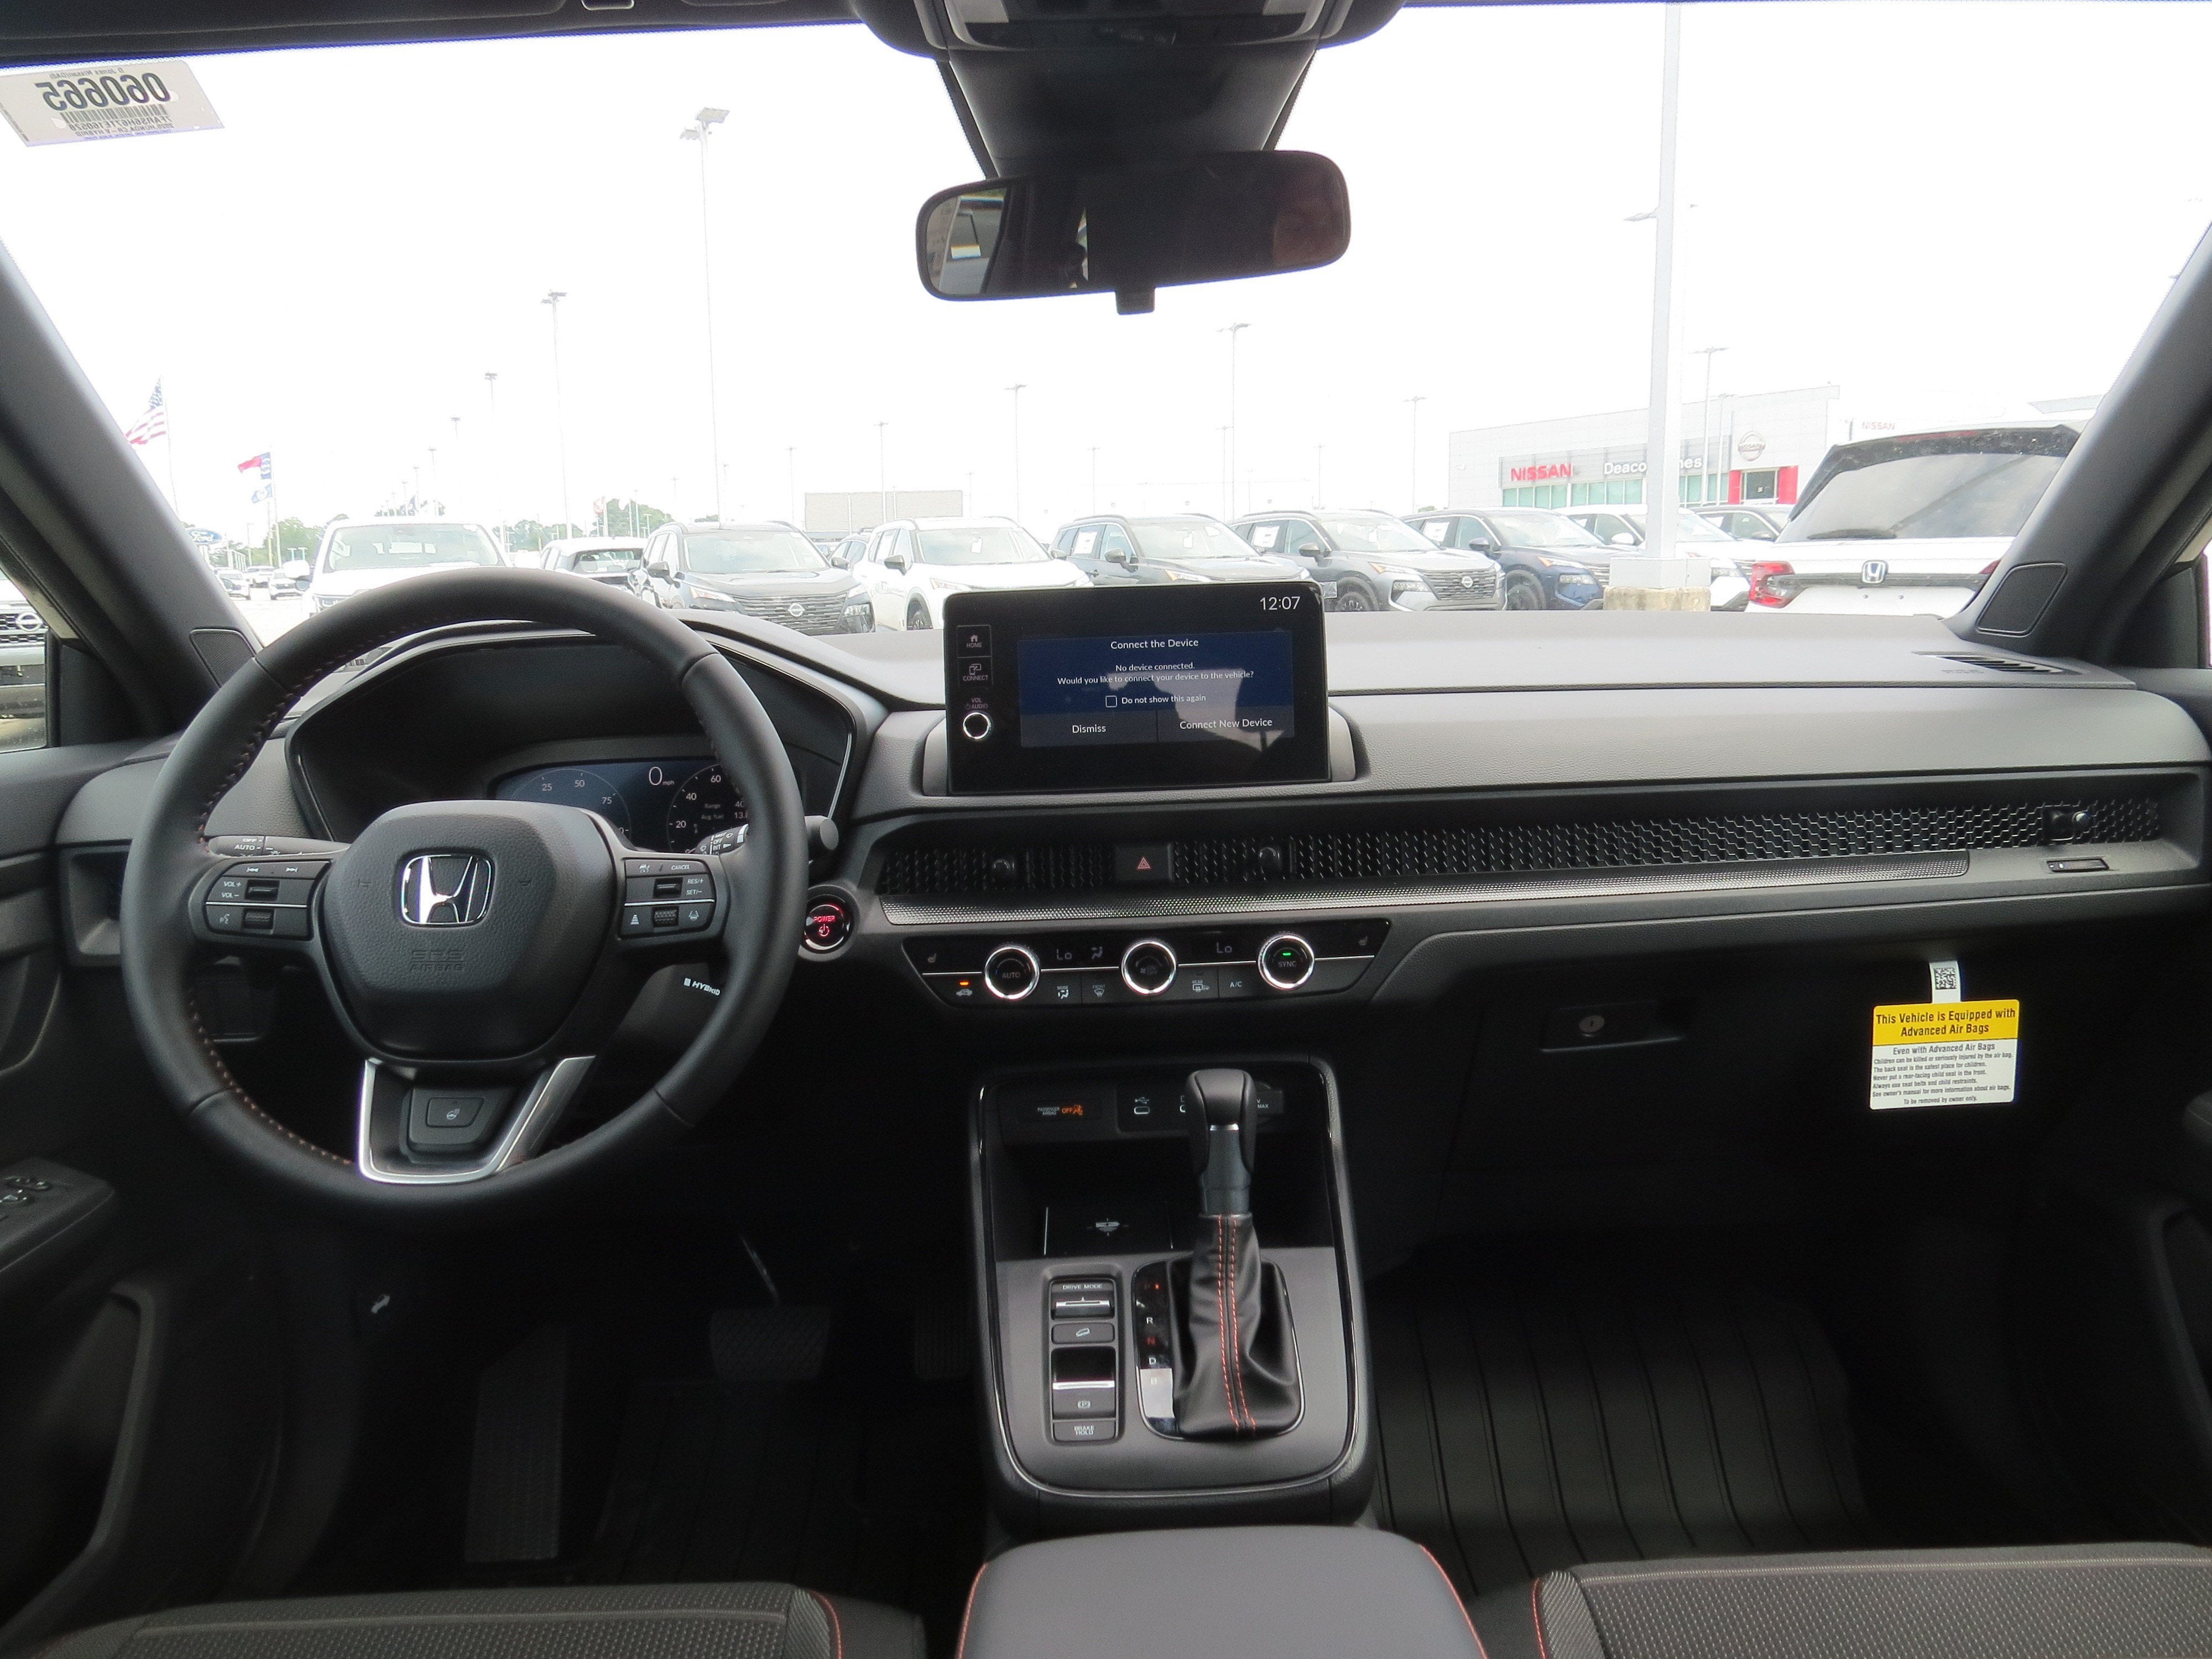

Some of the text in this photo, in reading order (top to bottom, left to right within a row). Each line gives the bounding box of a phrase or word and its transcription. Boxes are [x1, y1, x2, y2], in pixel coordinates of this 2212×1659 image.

[1861, 421, 1896, 430] NISSAN
[1511, 463, 1573, 481] NISSAN
[1604, 461, 1647, 476] Deaco
[190, 530, 215, 542] Ford
[1260, 596, 1301, 611] 12:07
[1110, 638, 1199, 649] Connect the Device
[1154, 662, 1196, 670] connected.
[1155, 674, 1174, 683] your
[1224, 670, 1254, 679] vehicle?
[1186, 694, 1206, 703] again
[1072, 724, 1106, 733] Dismiss
[1180, 718, 1272, 730] Connect New Device
[648, 766, 663, 786] 0
[711, 775, 722, 783] 60
[541, 783, 552, 791] 25
[574, 779, 585, 787] 50
[686, 792, 697, 801] 40
[676, 820, 687, 828] 20
[692, 980, 721, 996] HYBRID
[1876, 1008, 2016, 1024] This Vehicle is Equipped with
[1901, 1022, 1990, 1037] Advanced Air Bags
[1893, 1042, 1996, 1055] Even with Advanced Air Bags
